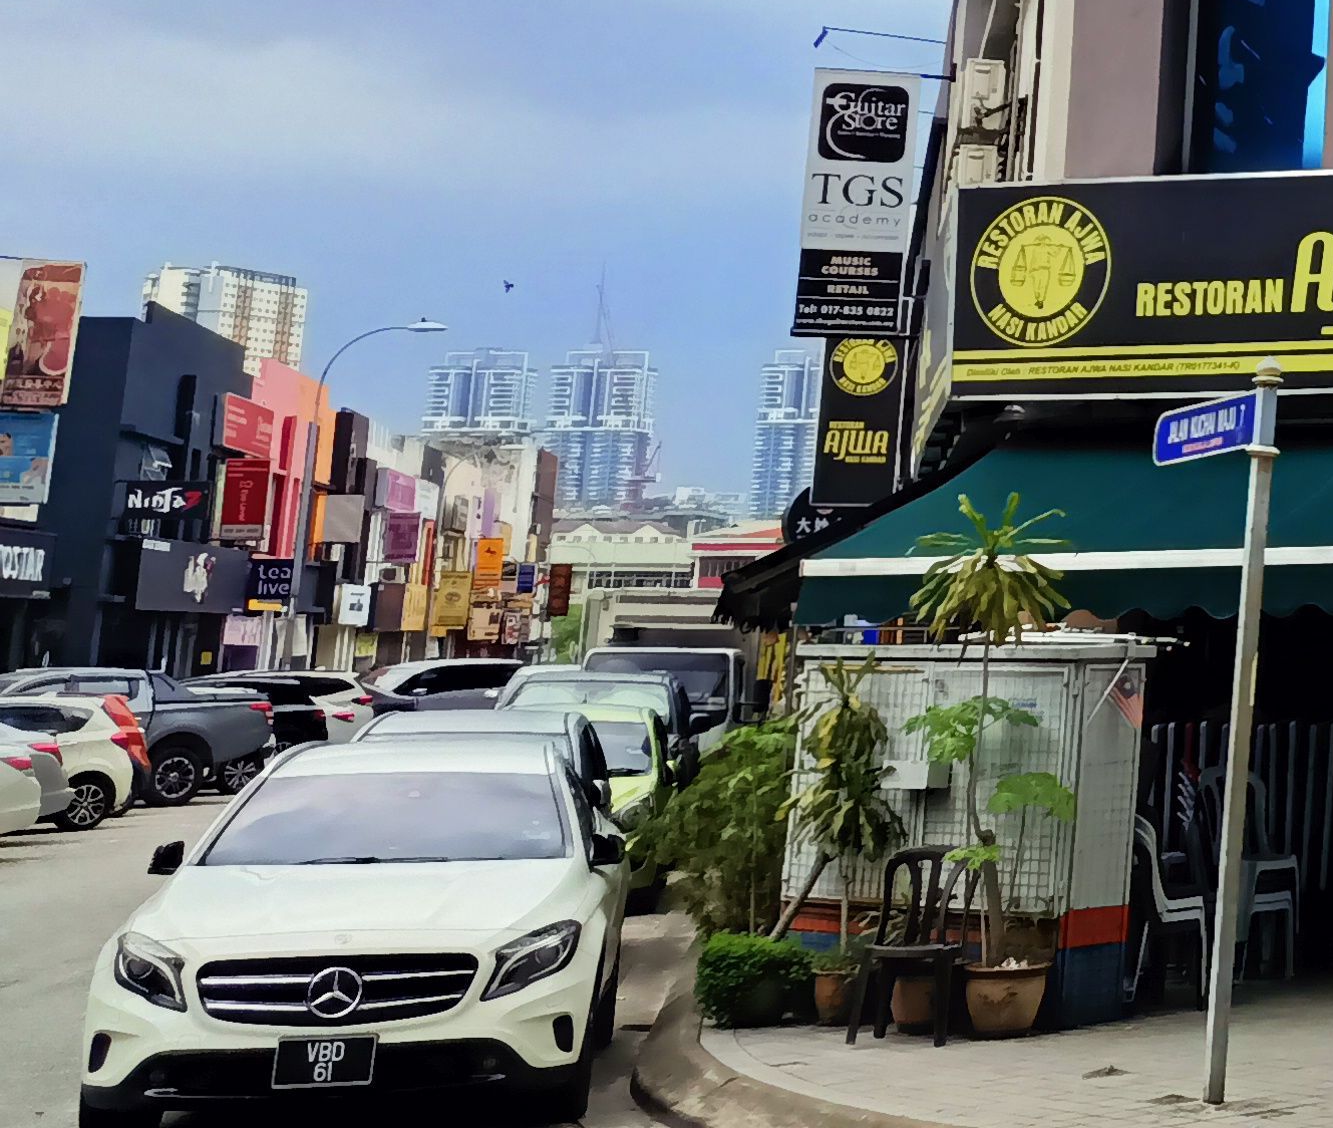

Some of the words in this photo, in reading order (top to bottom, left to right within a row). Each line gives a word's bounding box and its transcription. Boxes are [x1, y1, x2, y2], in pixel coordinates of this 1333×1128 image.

[826, 92, 906, 116] Guitar
[842, 112, 898, 130] Store
[811, 173, 903, 208] TGS
[808, 214, 901, 227] academy
[977, 202, 1064, 269] RESTORAN
[1064, 210, 1107, 265] AJWA
[830, 256, 871, 266] MUSIC
[1135, 278, 1284, 317] RESTORAN
[987, 303, 1025, 338] NASI
[1025, 302, 1088, 341] KANDAR
[1028, 366, 1078, 375] RESTORAN
[1134, 362, 1174, 371] KANDAR
[824, 430, 889, 460] AJWA
[258, 581, 290, 595] live
[307, 1042, 345, 1062] VBD
[313, 1062, 332, 1081] 61
